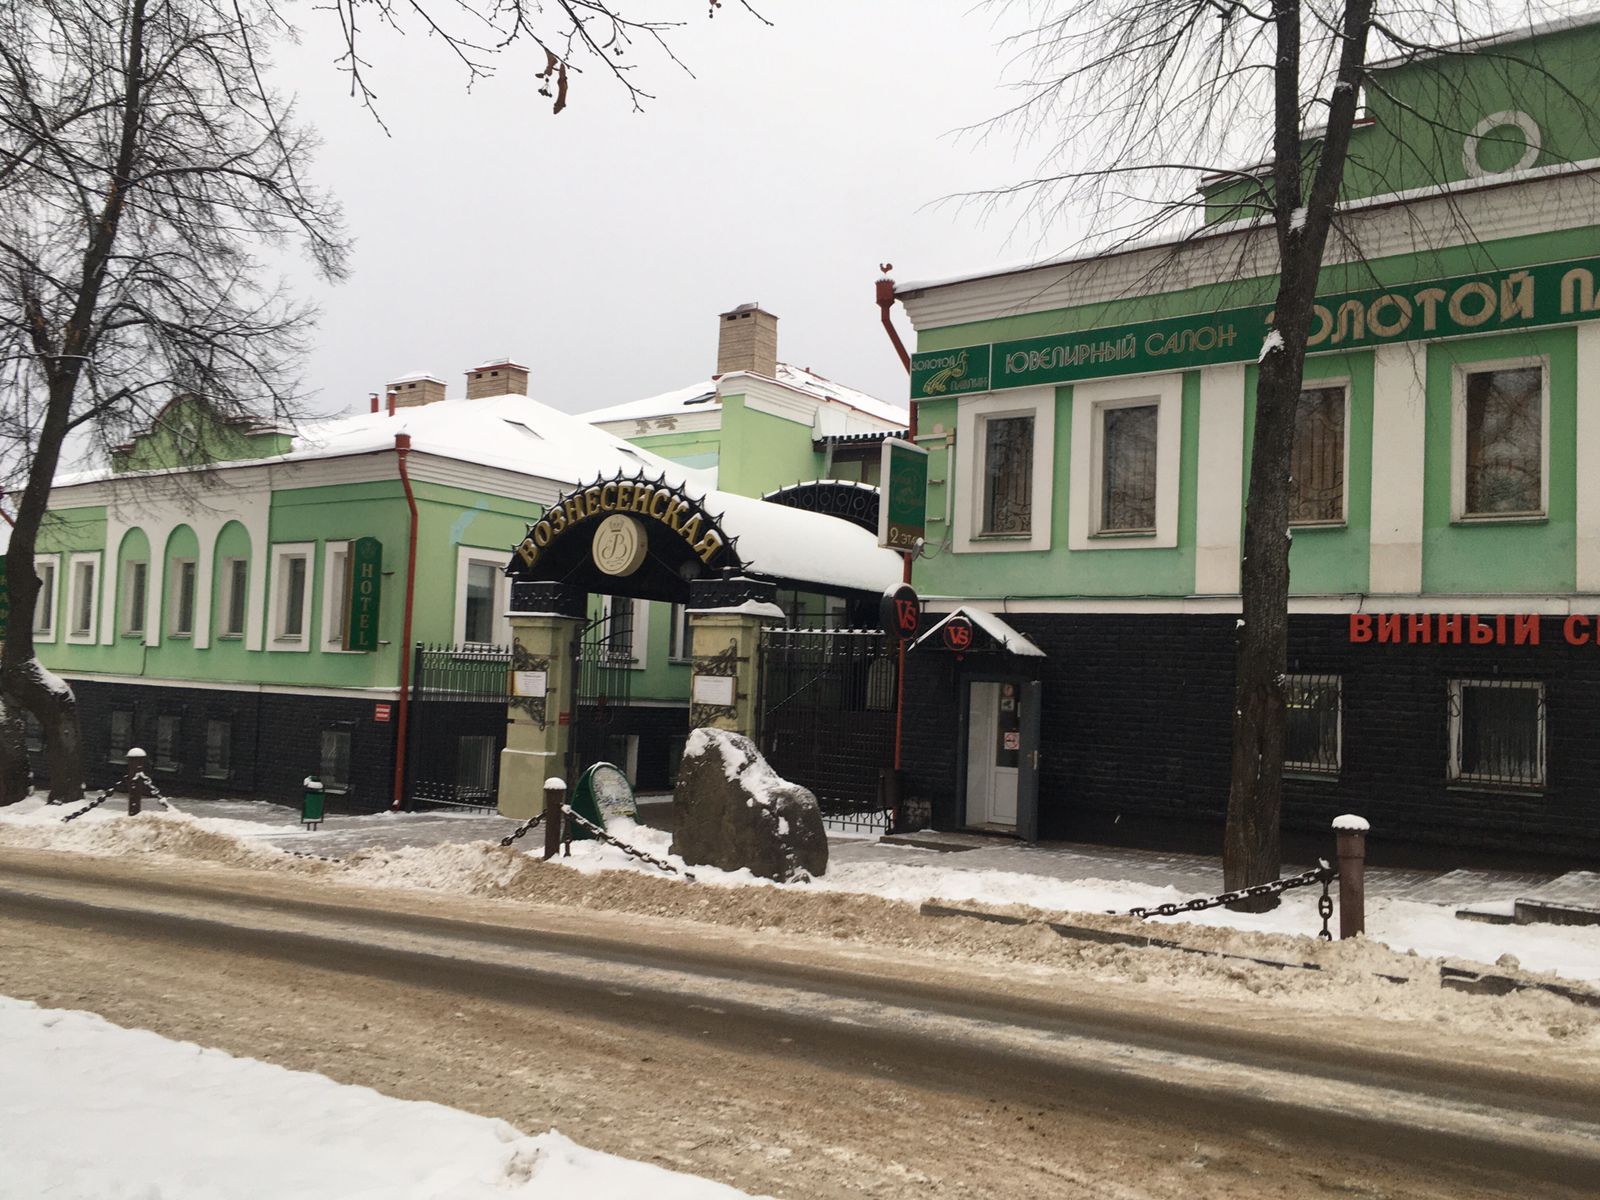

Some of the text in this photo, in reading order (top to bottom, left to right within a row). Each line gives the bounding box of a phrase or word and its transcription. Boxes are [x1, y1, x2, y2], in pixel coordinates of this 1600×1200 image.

[1263, 268, 1600, 347] ОЛОТОЙ П
[1005, 323, 1238, 374] ЮВЕЛИРНЫЙ САЛОН
[518, 480, 723, 567] ВОЗНЕСЕНСКАЯ
[890, 527, 899, 543] 2
[358, 563, 373, 645] HOTEL
[896, 599, 917, 631] VS
[948, 626, 970, 645] VS
[1563, 614, 1600, 645] С
